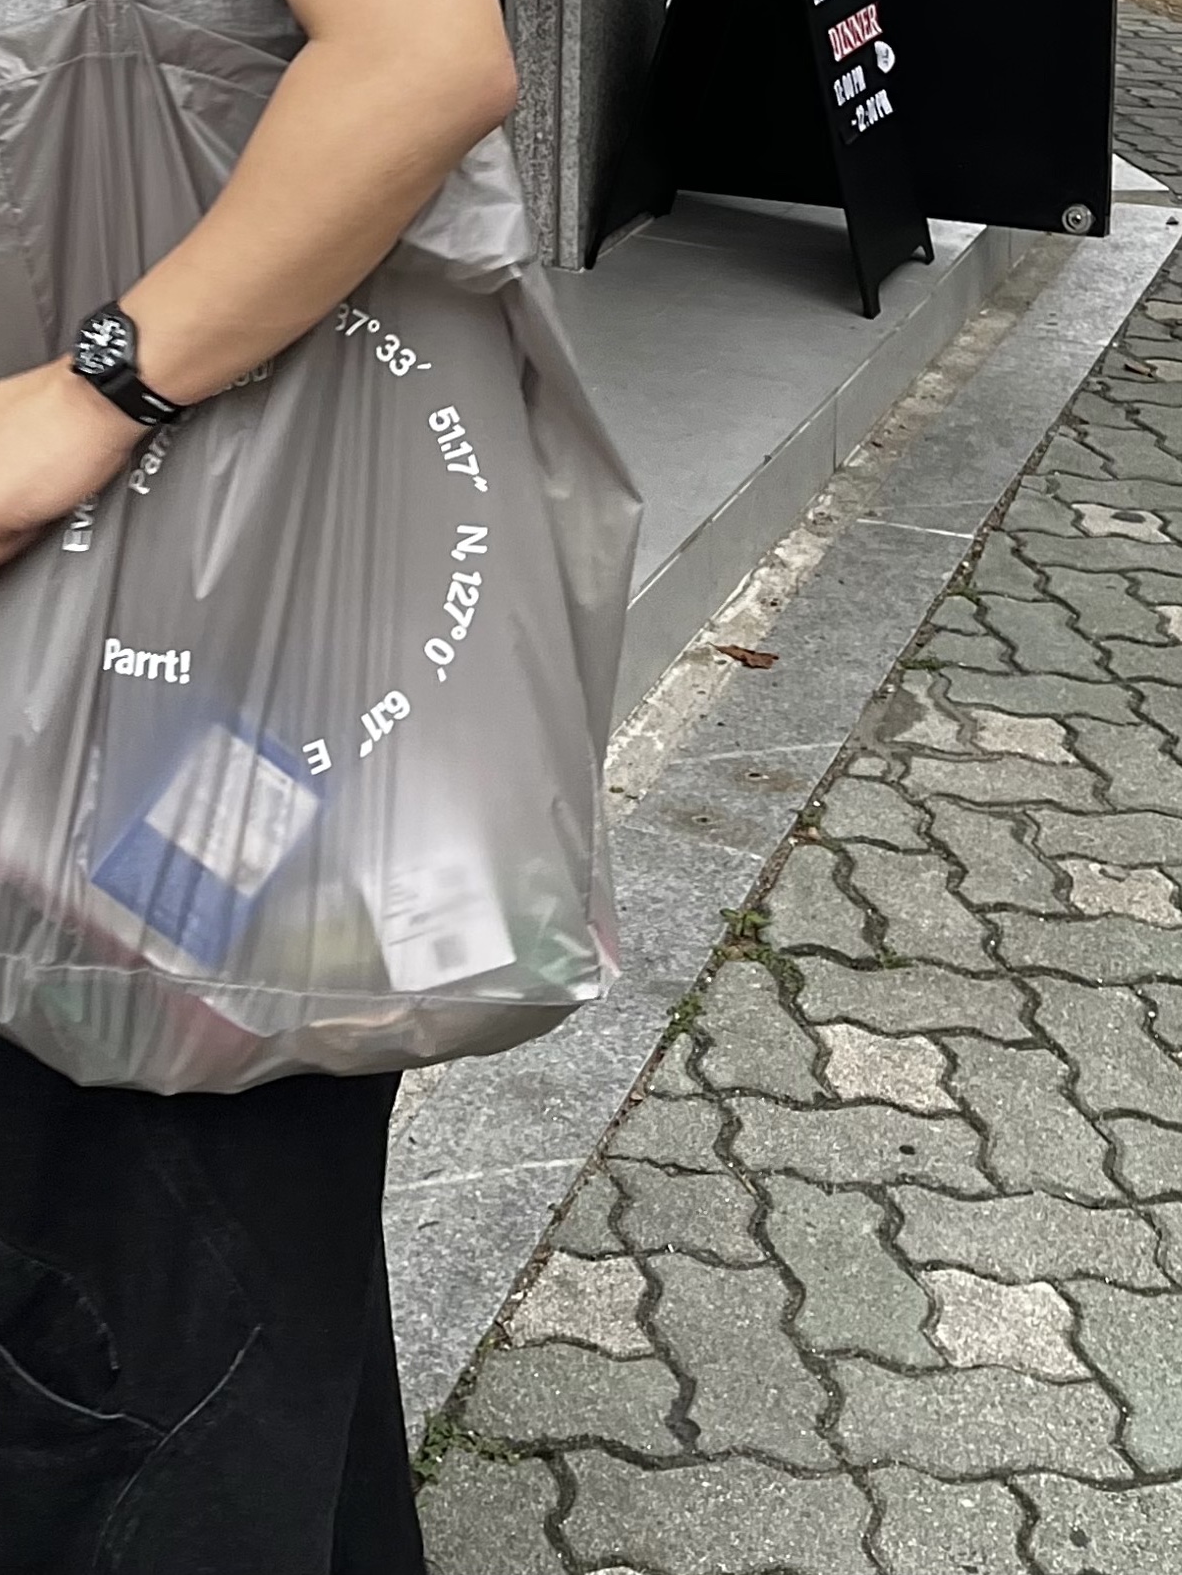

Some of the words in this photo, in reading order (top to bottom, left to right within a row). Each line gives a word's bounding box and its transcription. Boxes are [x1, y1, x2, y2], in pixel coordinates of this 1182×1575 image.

[828, 3, 883, 62] DINNER
[102, 637, 191, 685] Parrt!
[302, 737, 332, 776] E
